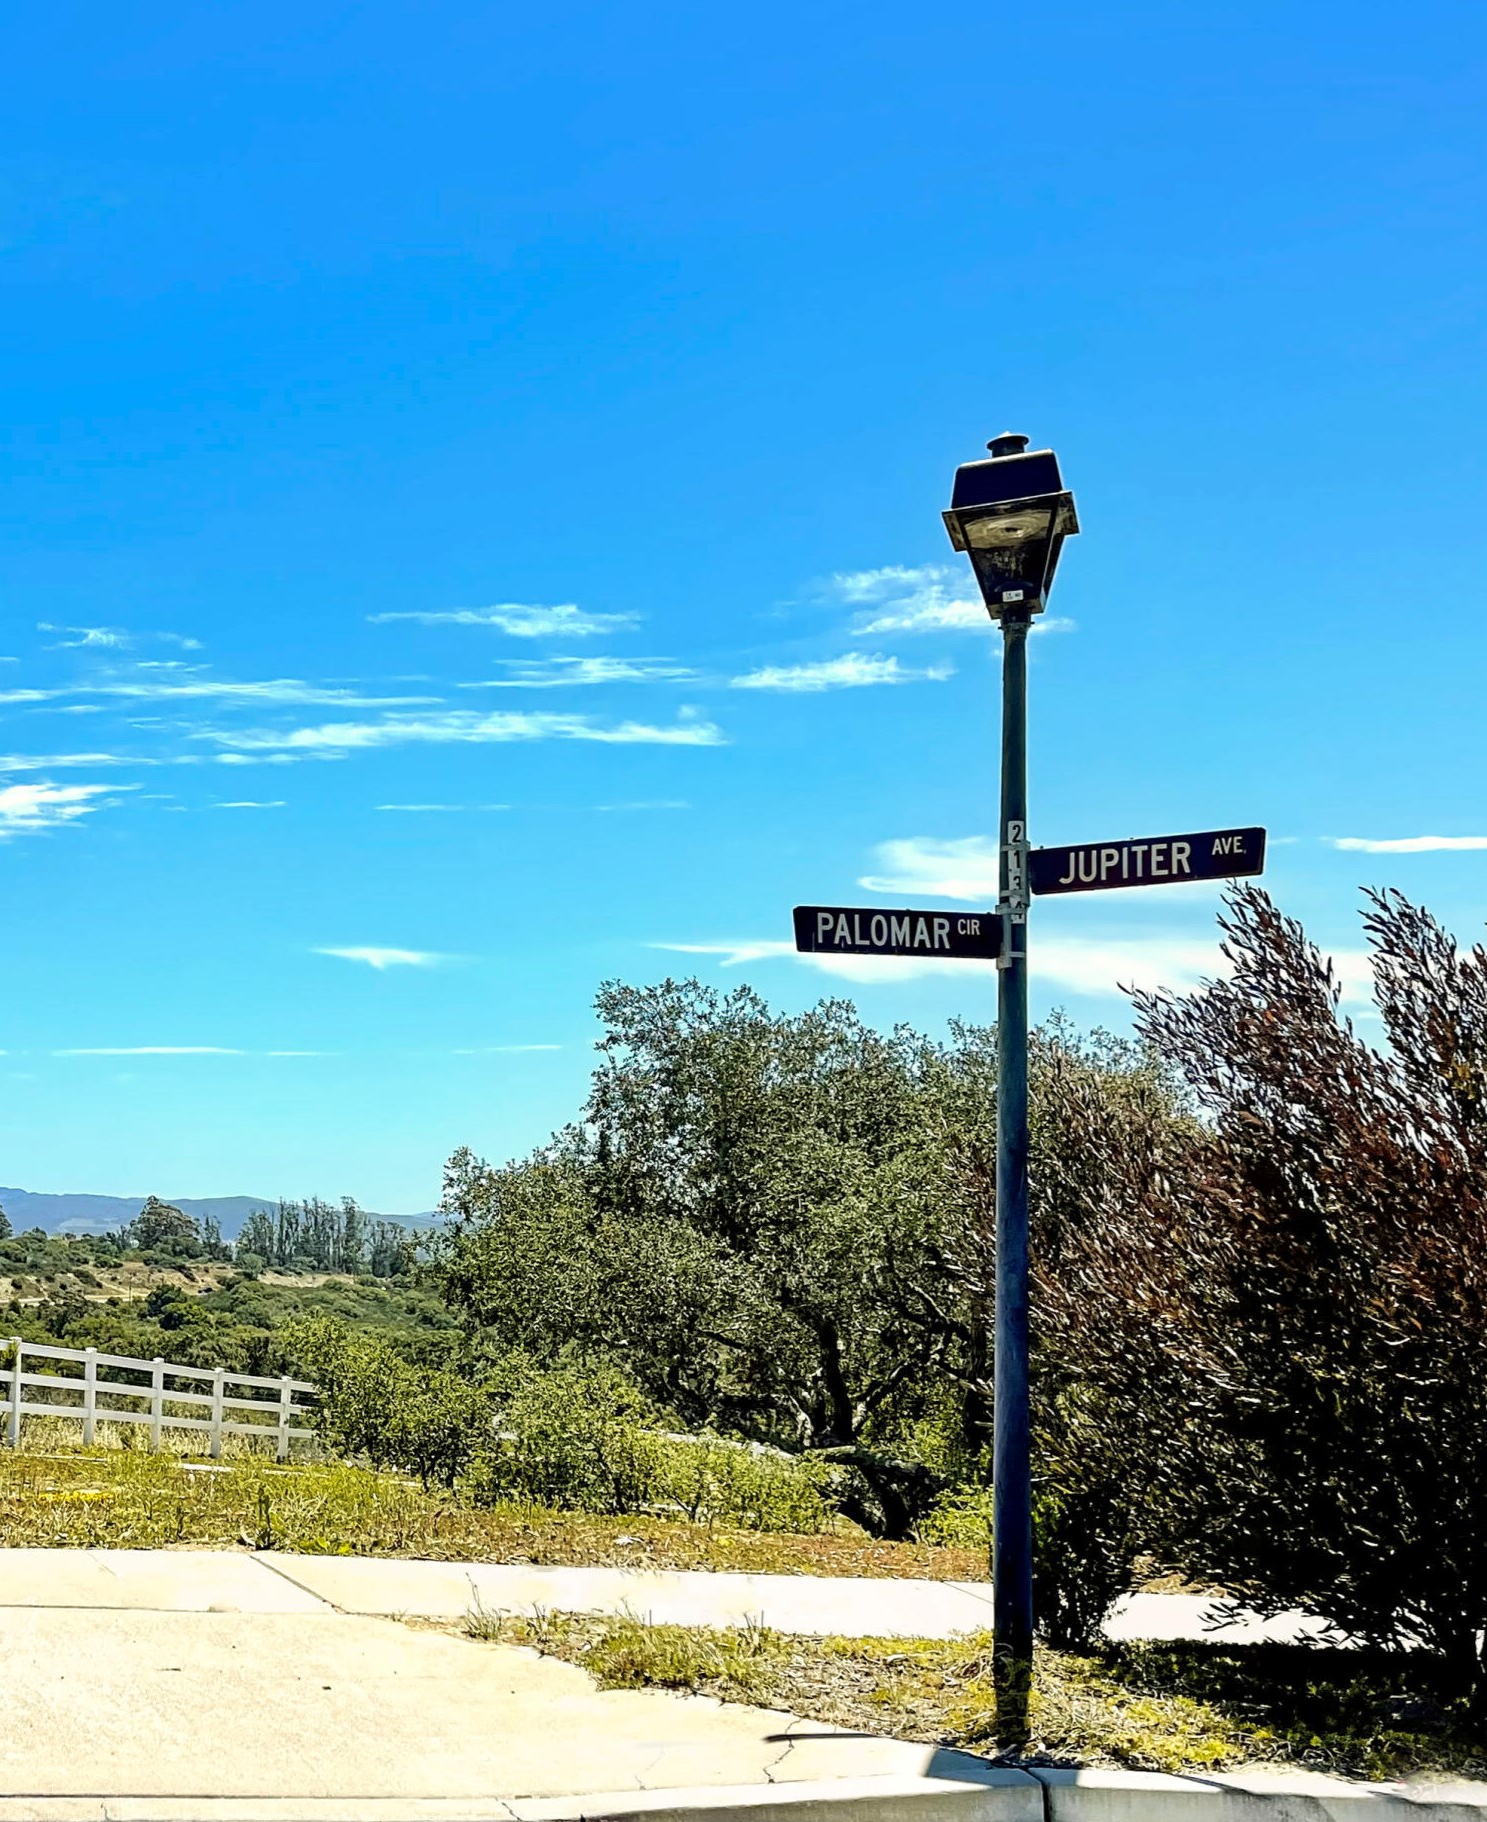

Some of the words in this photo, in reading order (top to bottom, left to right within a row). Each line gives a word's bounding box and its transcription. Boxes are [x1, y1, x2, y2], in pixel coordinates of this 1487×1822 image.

[1058, 841, 1192, 885] JUPITER
[816, 912, 951, 949] PALOMAR
[957, 919, 981, 936] CIR
